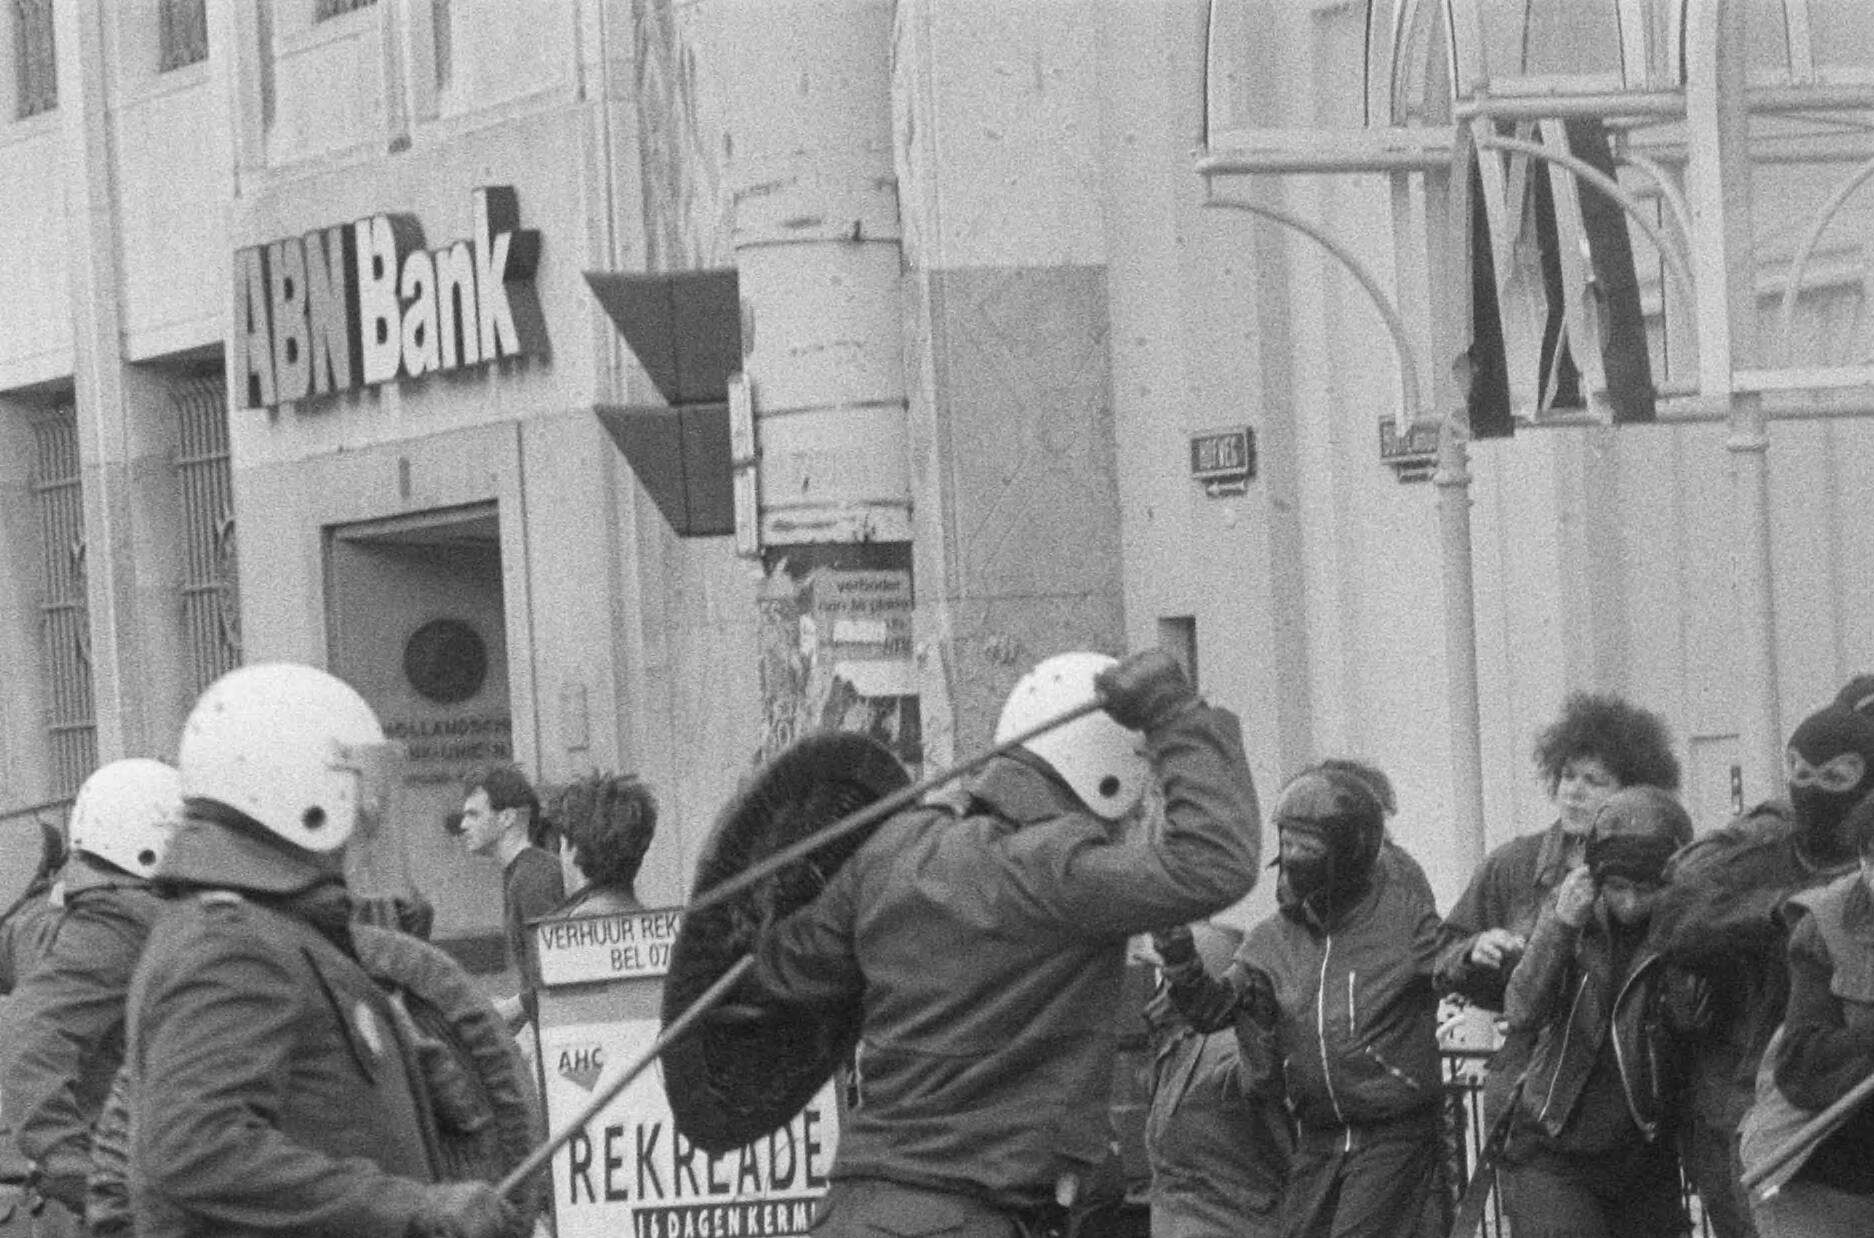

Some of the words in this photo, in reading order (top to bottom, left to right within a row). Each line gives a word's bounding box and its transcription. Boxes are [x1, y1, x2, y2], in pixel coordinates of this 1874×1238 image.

[233, 228, 352, 408] ABN
[355, 187, 525, 385] Bank
[540, 917, 635, 950] VERHUUR
[611, 946, 646, 971] BEL
